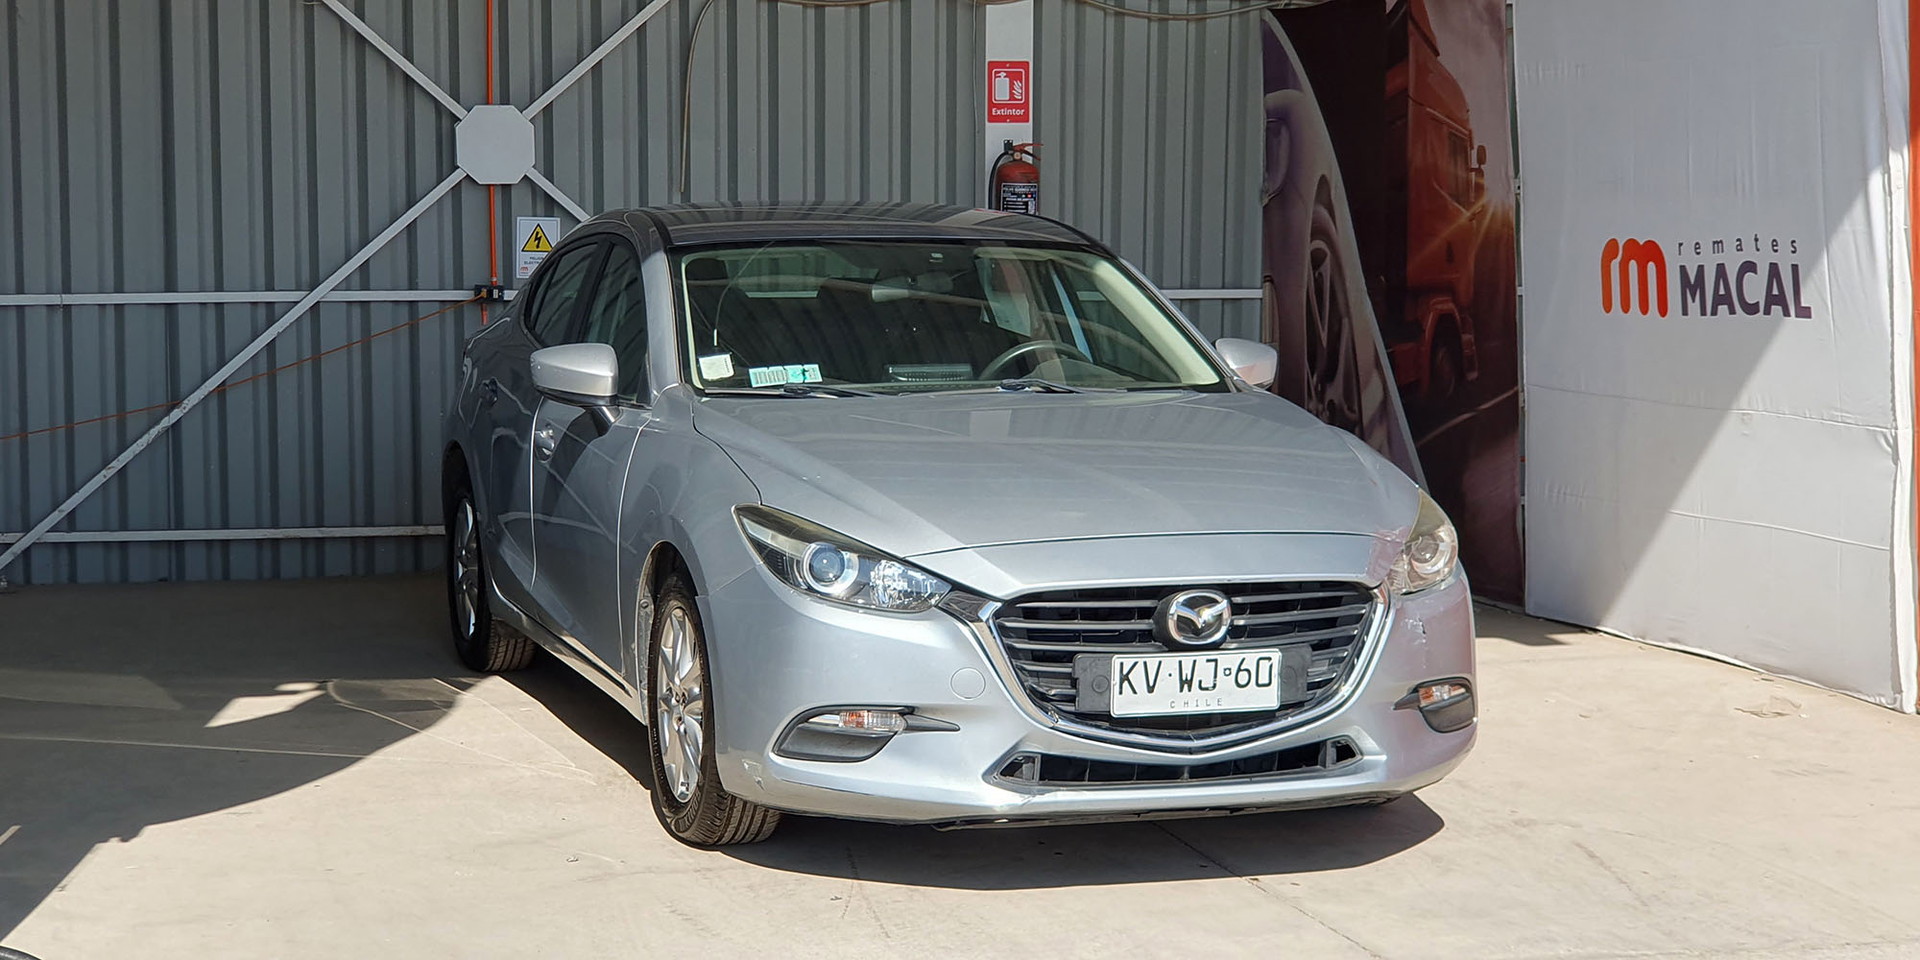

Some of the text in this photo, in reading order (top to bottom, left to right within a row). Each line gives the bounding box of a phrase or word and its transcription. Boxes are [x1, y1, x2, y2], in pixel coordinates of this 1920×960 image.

[992, 107, 1025, 116] Extintor
[1678, 234, 1798, 256] remates
[1678, 260, 1812, 319] MACAL
[1169, 697, 1224, 709] CHILE
